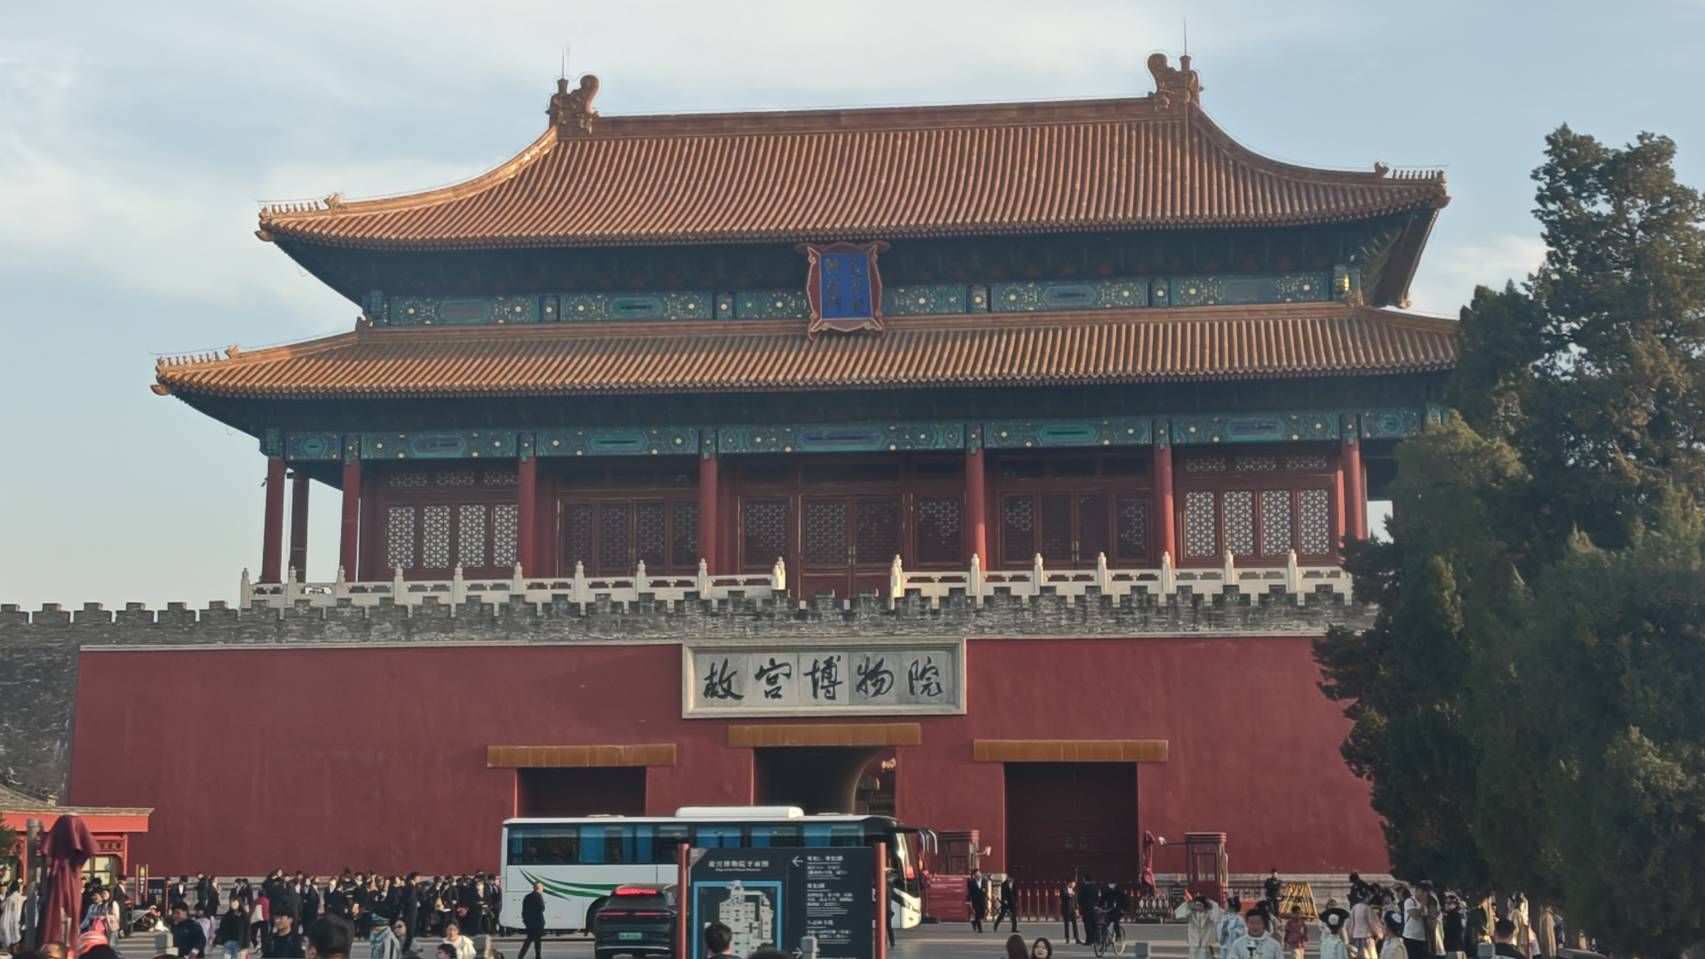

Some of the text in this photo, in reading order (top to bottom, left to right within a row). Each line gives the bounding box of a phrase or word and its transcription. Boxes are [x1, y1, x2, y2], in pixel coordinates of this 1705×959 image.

[703, 655, 944, 700] 故宫博物院
